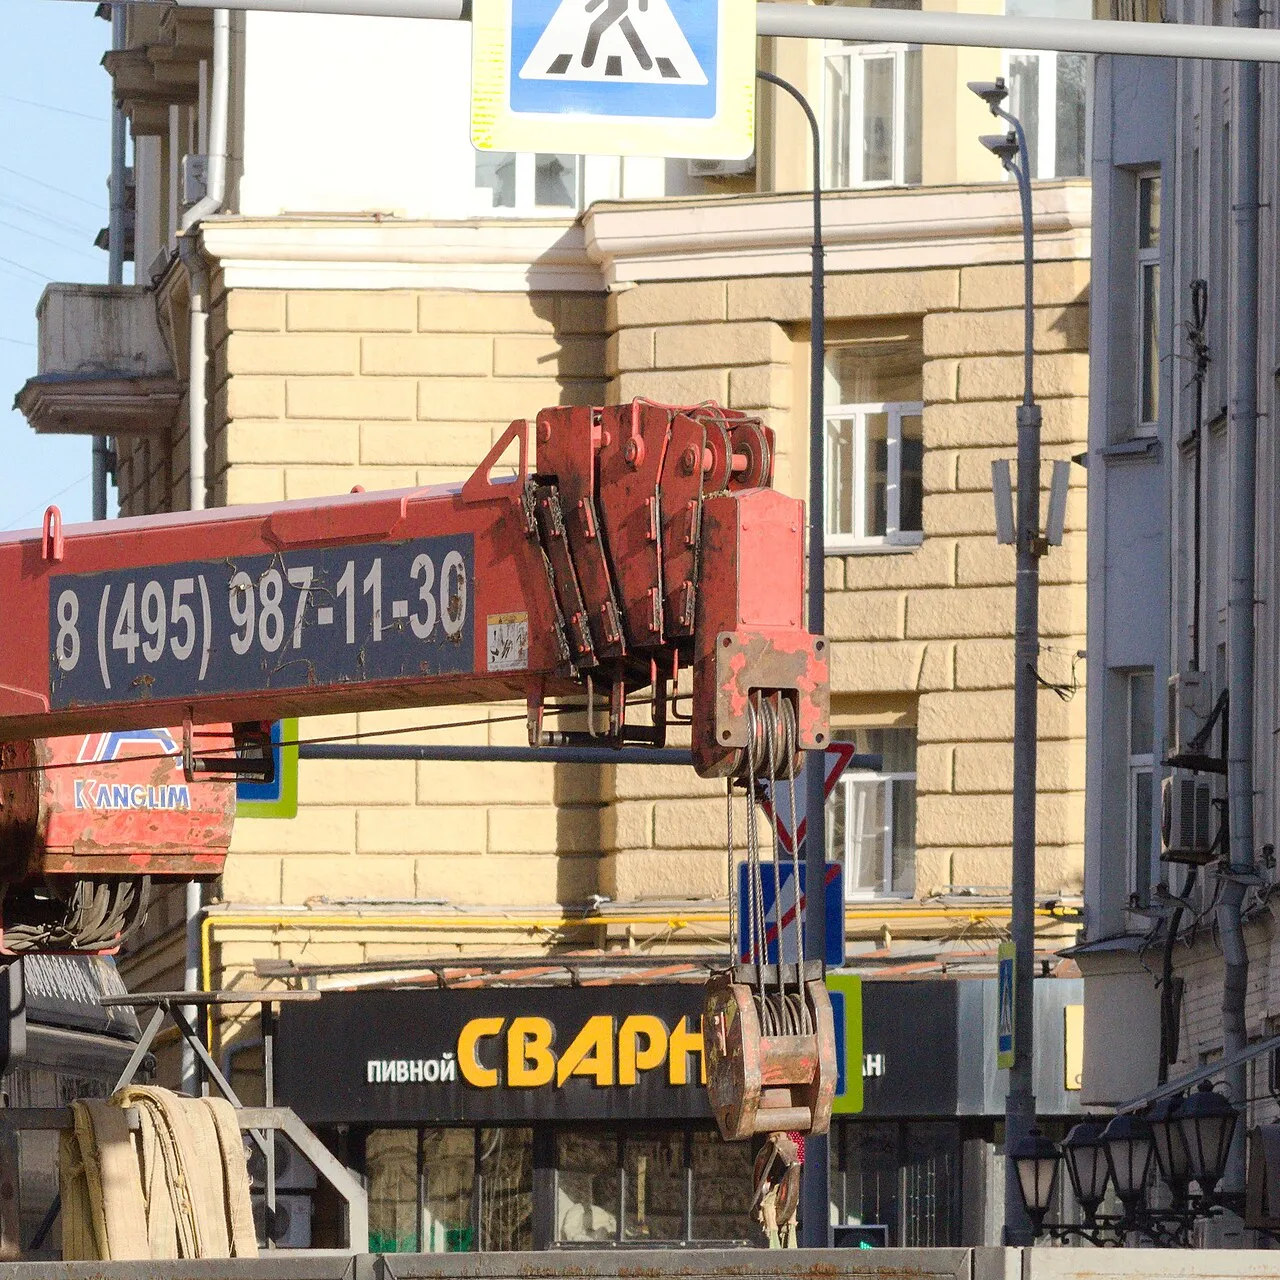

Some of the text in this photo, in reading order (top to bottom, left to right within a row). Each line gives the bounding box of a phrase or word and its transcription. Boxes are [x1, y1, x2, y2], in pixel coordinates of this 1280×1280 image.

[56, 589, 80, 672] 8
[97, 574, 212, 690] (495)
[228, 549, 468, 656] 987-11-30
[73, 778, 192, 811] KANGLIM
[366, 1014, 708, 1088] ПИВНОЙ СВАРН
